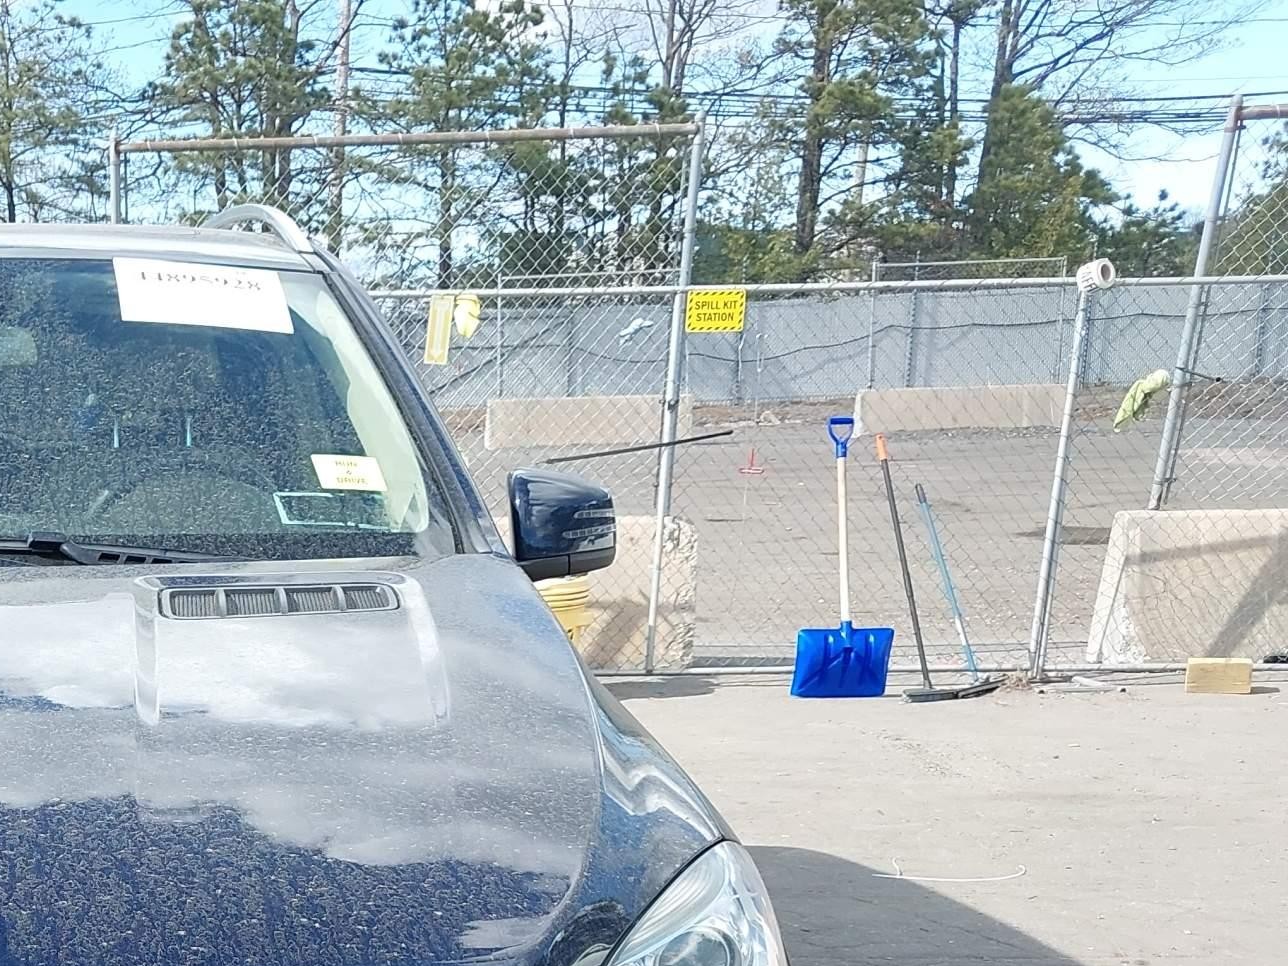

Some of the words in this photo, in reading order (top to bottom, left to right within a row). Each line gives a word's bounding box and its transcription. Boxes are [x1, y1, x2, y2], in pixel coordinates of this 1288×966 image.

[695, 301, 720, 309] SPILL
[723, 300, 738, 309] KIT
[696, 313, 734, 321] STATION
